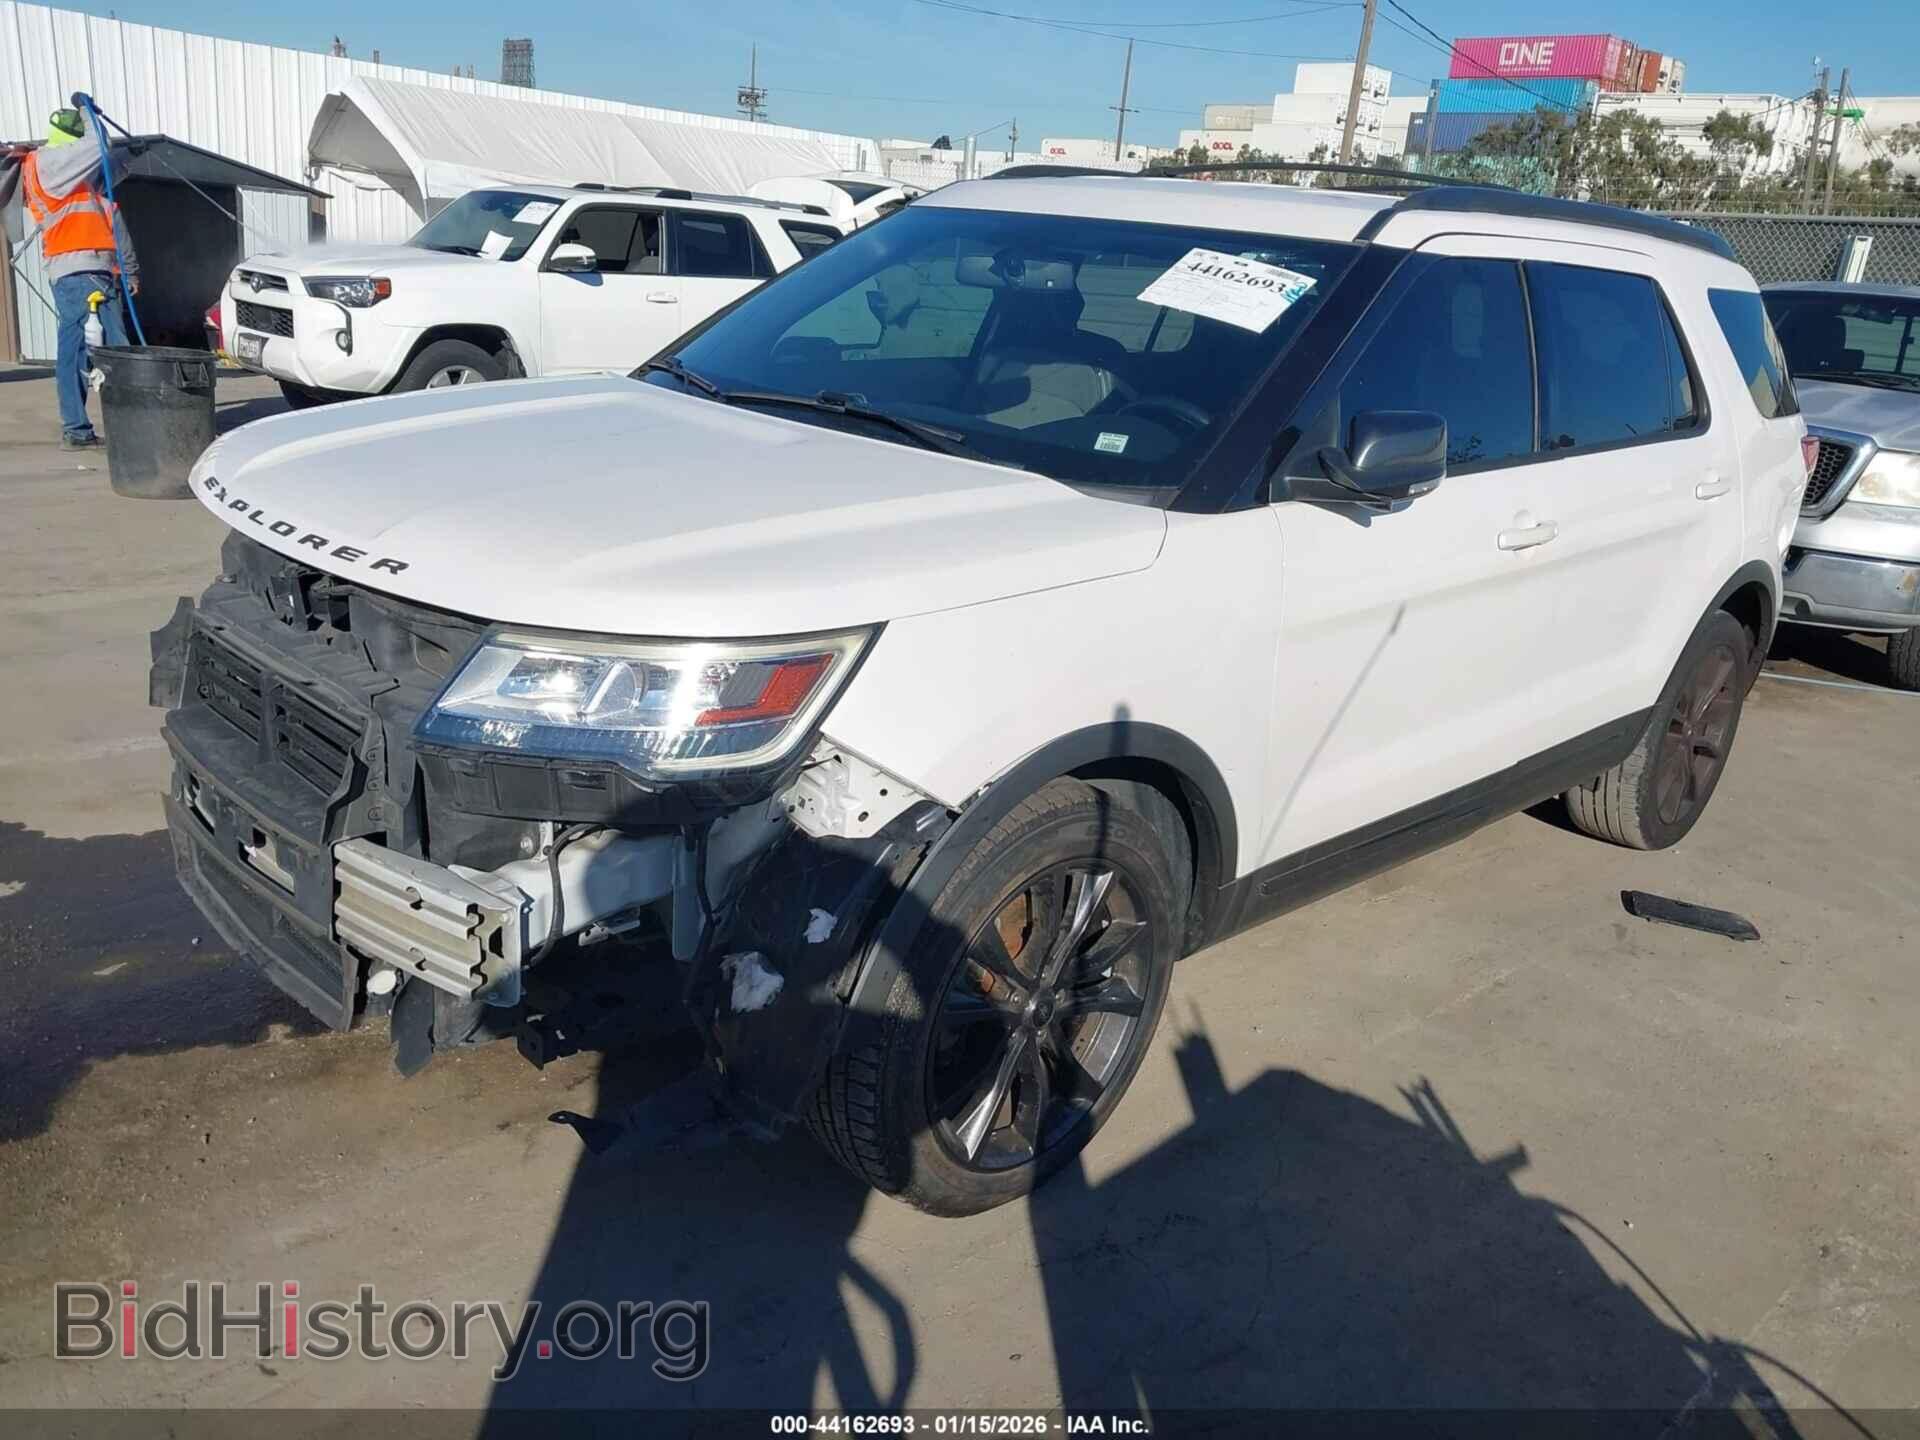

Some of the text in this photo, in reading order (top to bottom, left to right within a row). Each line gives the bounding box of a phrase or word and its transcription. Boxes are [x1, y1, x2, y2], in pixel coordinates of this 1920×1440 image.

[1498, 42, 1555, 65] ONE
[1187, 262, 1287, 294] 44162693
[203, 476, 410, 575] EXPLORER
